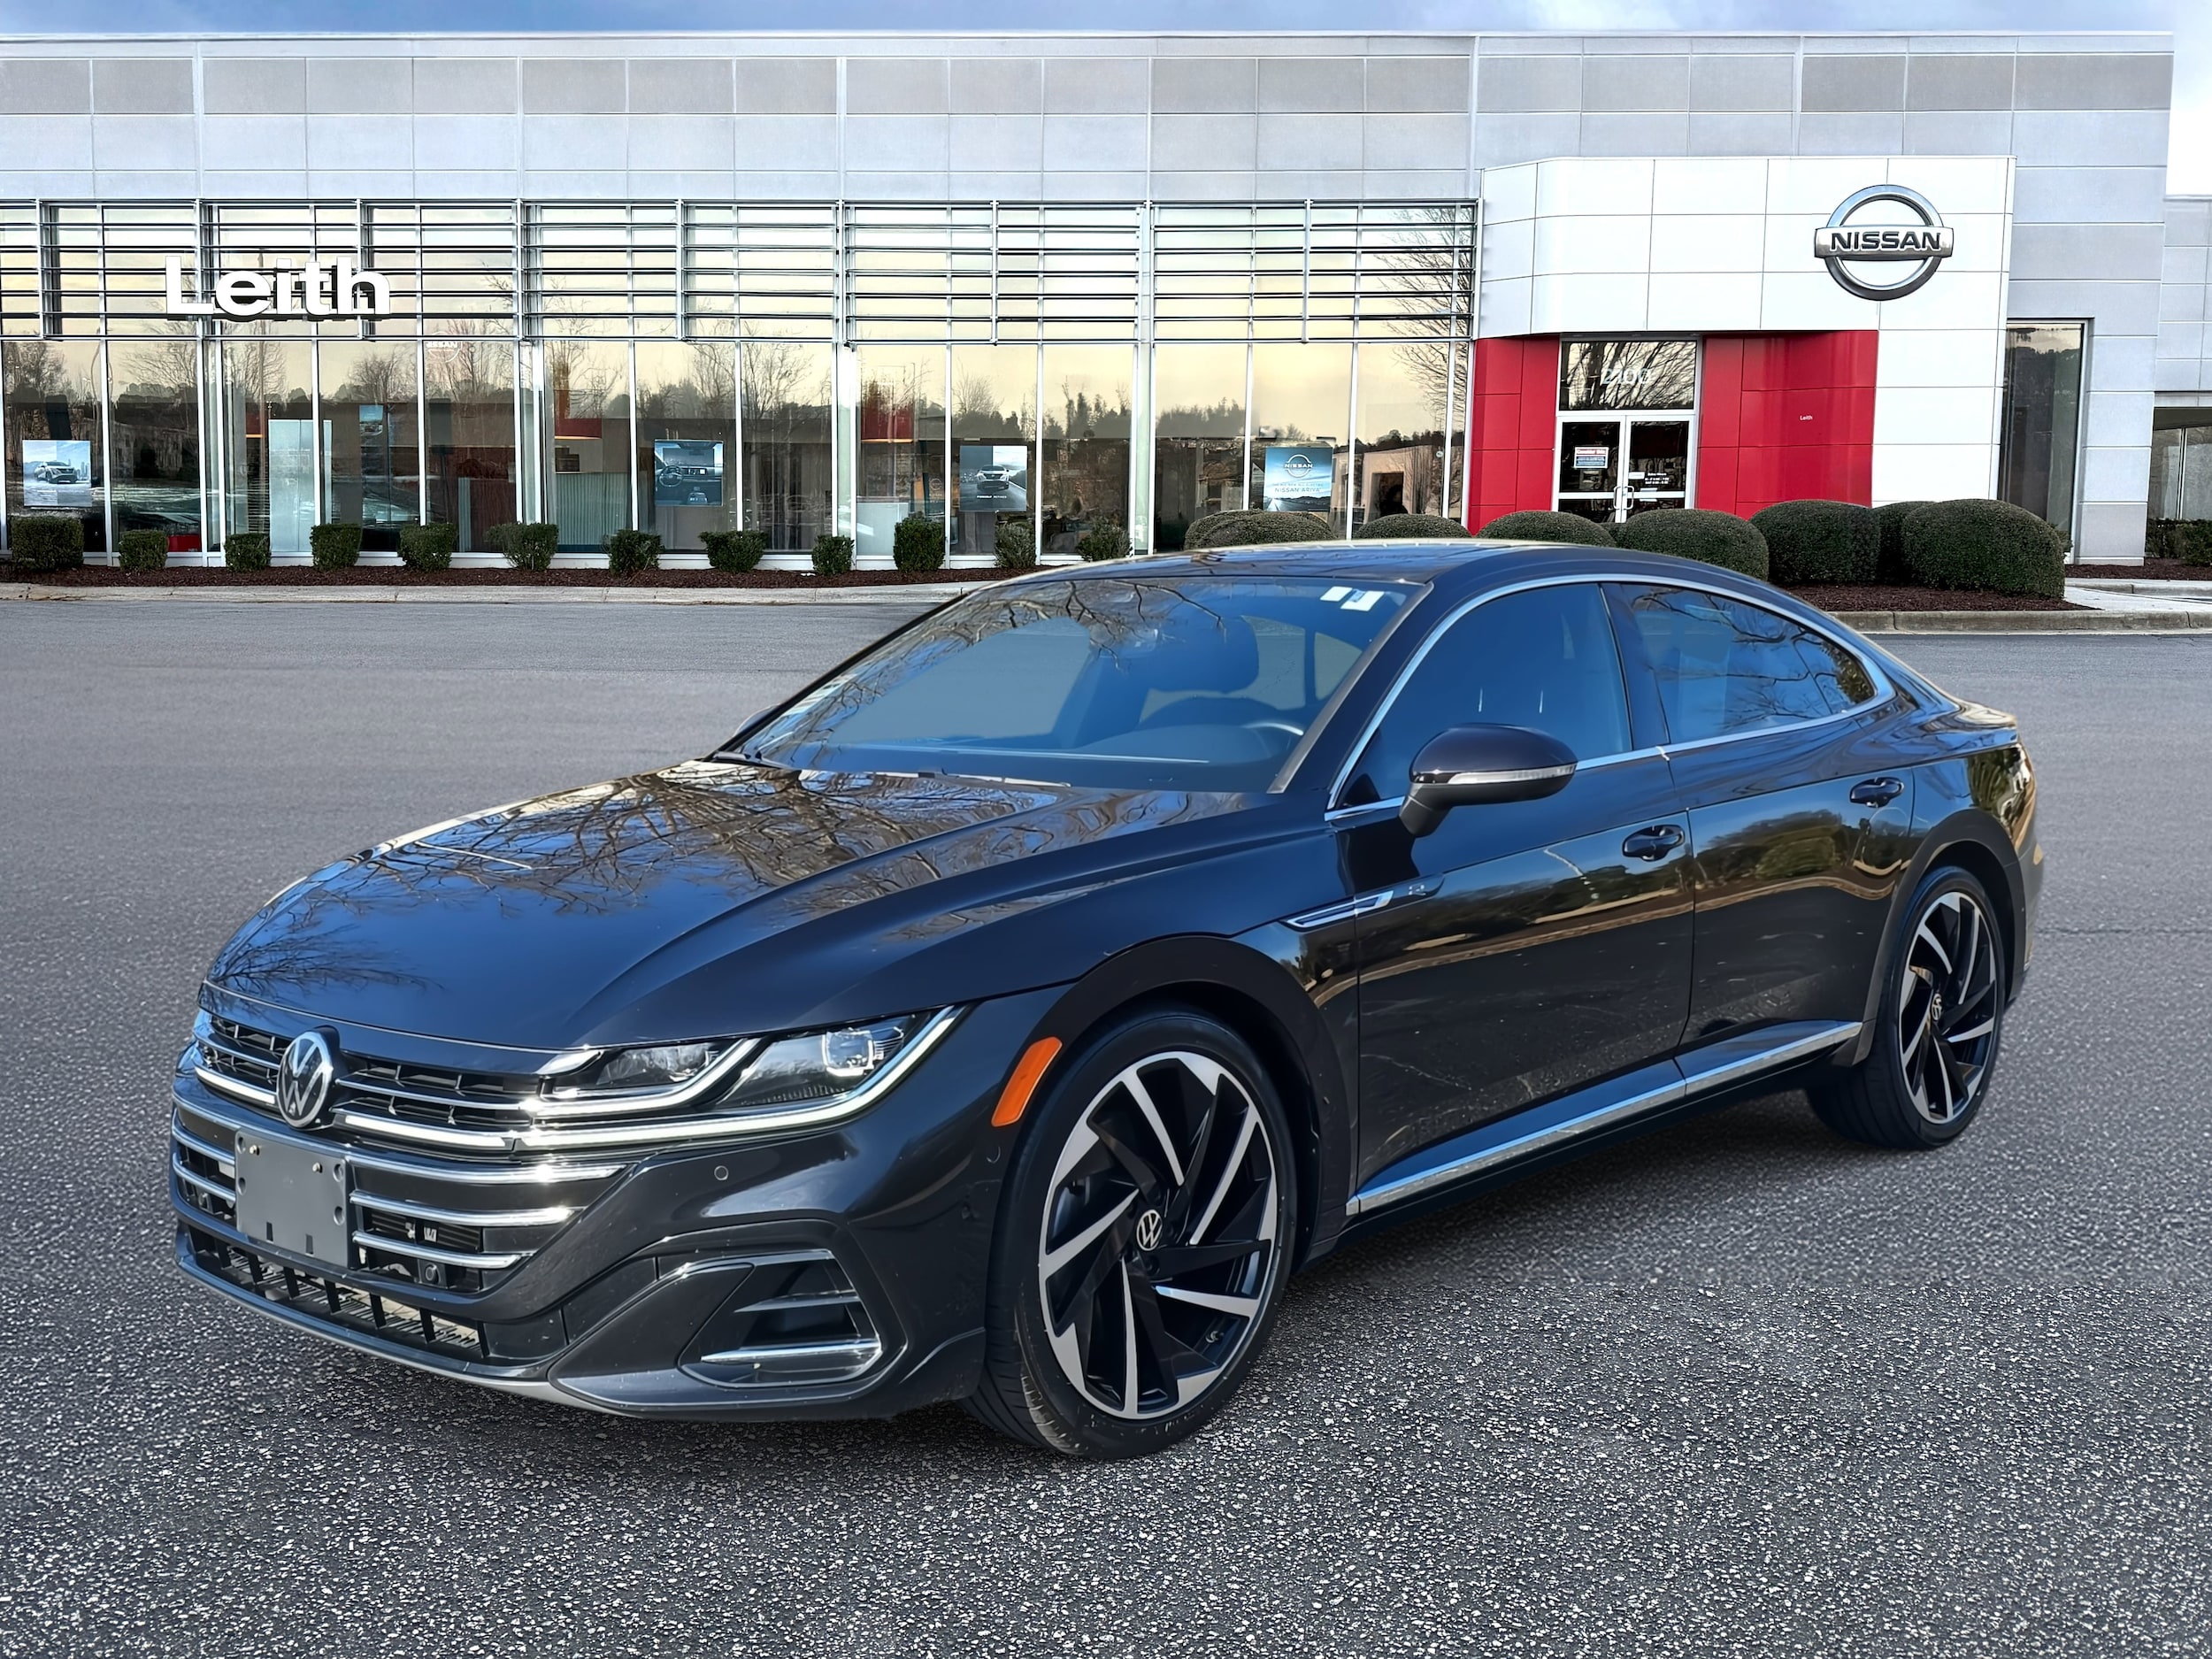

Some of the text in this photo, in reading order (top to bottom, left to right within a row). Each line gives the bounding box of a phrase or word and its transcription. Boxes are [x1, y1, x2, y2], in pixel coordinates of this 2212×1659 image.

[1831, 231, 1941, 250] NISSAN
[165, 256, 390, 316] Leith
[1603, 368, 1650, 384] 2100
